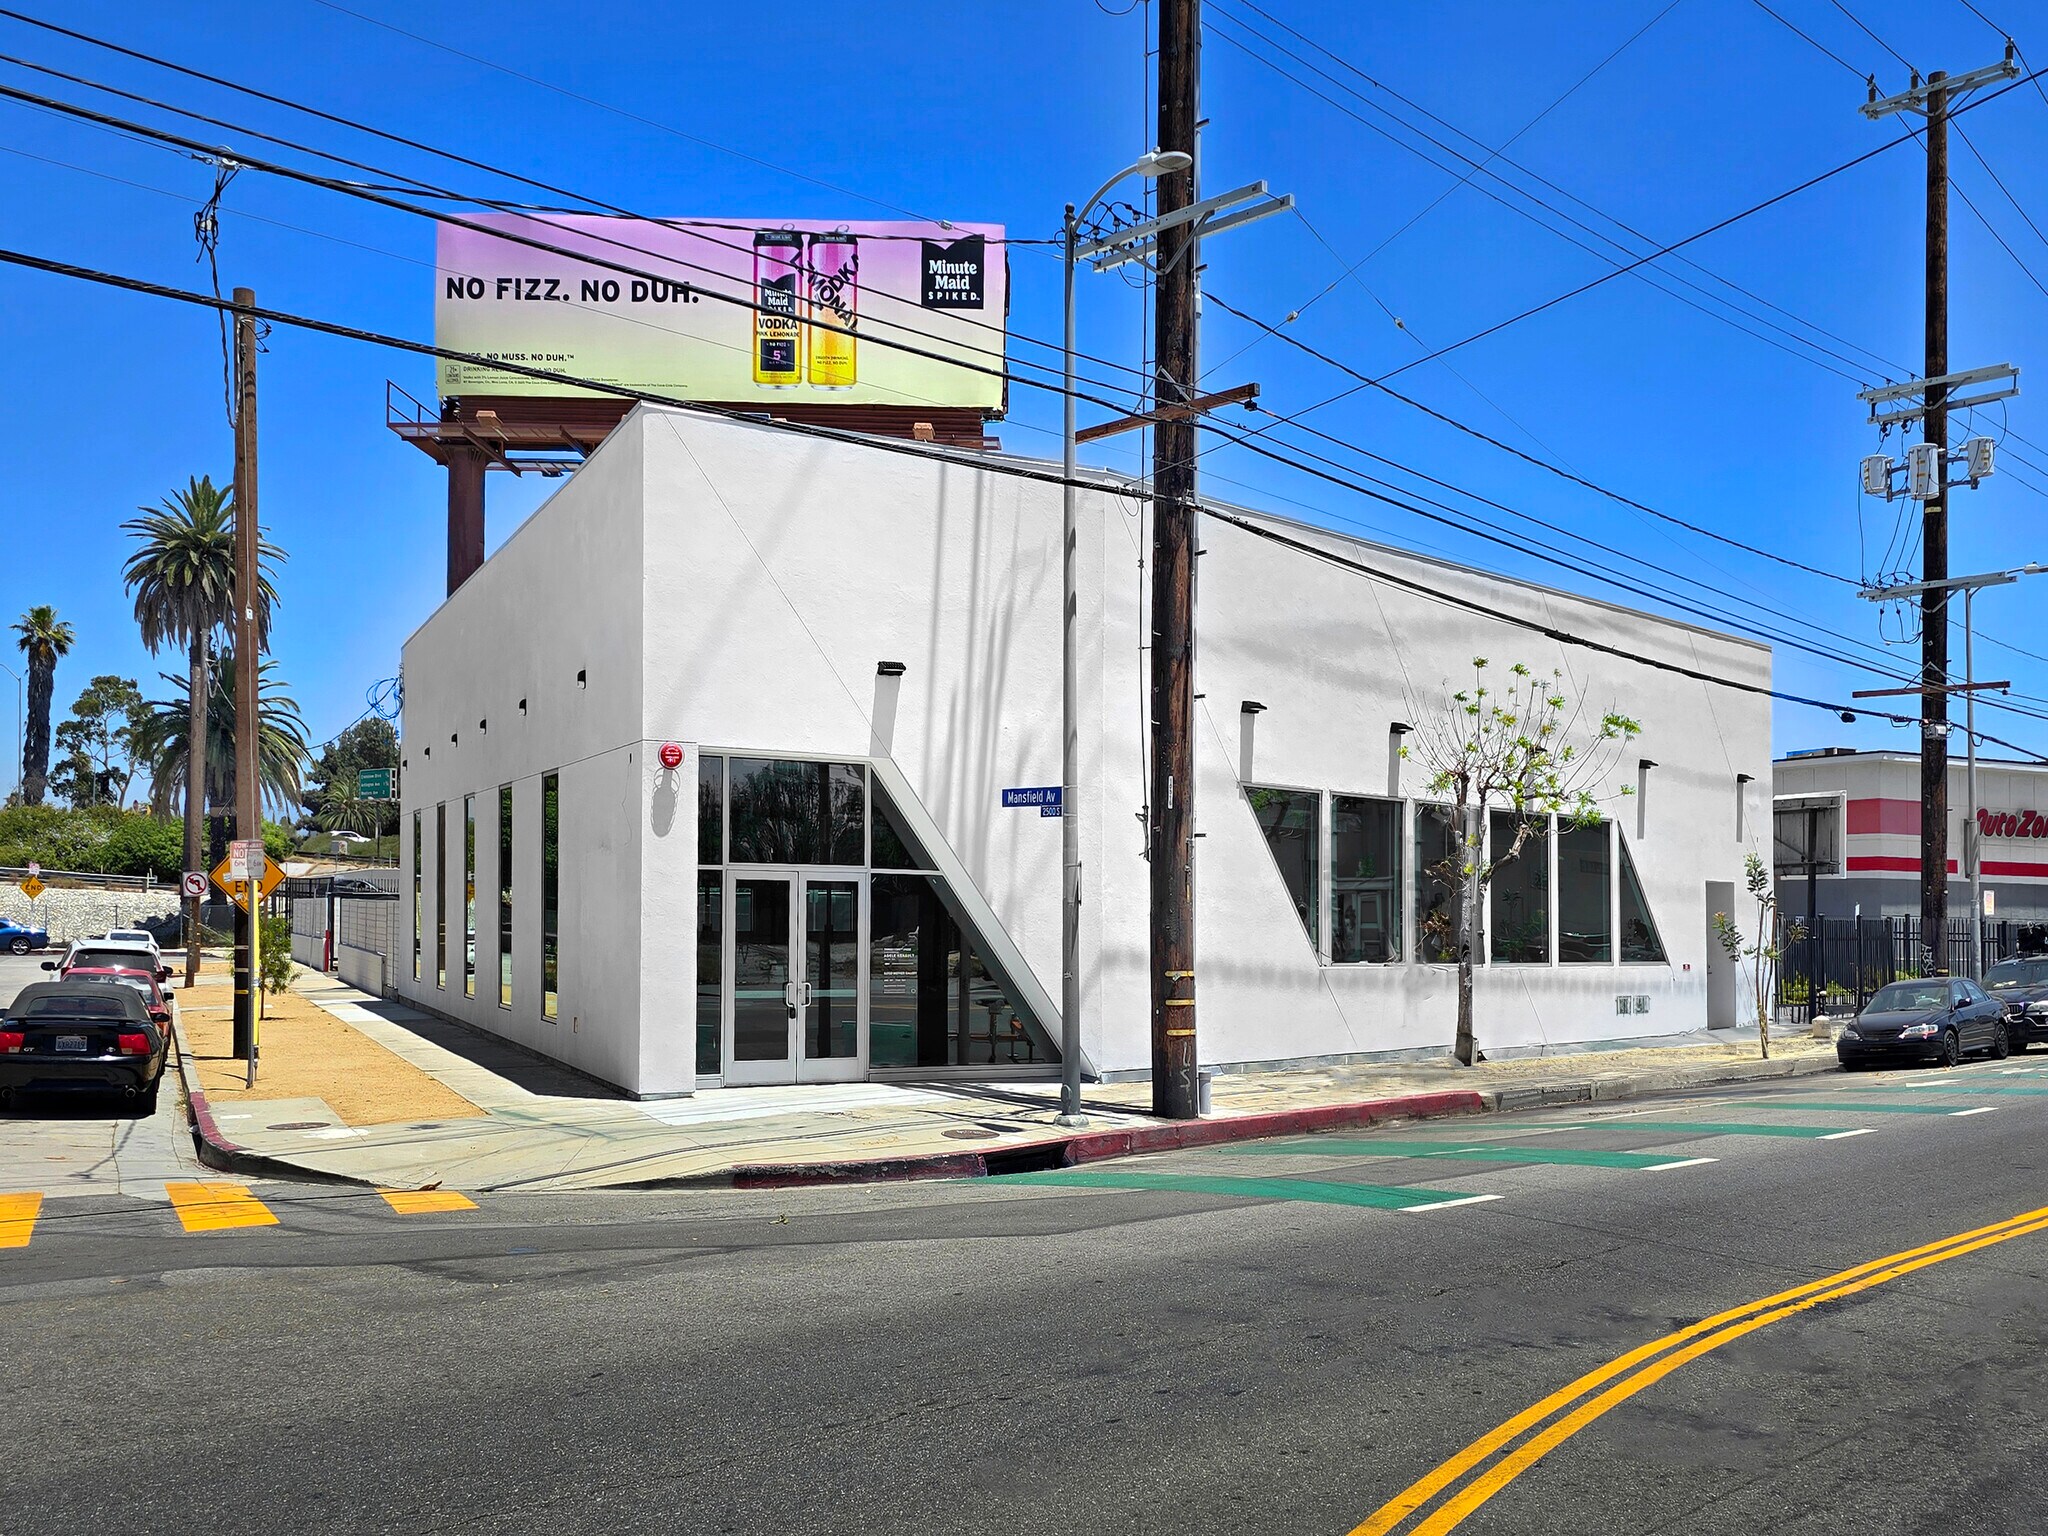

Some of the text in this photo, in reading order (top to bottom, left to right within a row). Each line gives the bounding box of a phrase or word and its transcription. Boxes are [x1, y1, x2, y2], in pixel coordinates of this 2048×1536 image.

[928, 259, 978, 275] Minute
[934, 274, 971, 290] Maid
[446, 277, 700, 304] NO FIZZ. NO DUH.
[767, 297, 789, 306] Maid
[758, 317, 799, 330] VODKA
[486, 352, 499, 361] NO
[501, 352, 529, 362] MUSS.
[531, 353, 544, 362] NO
[1007, 790, 1056, 804] Mansfield Av
[233, 849, 245, 858] NO
